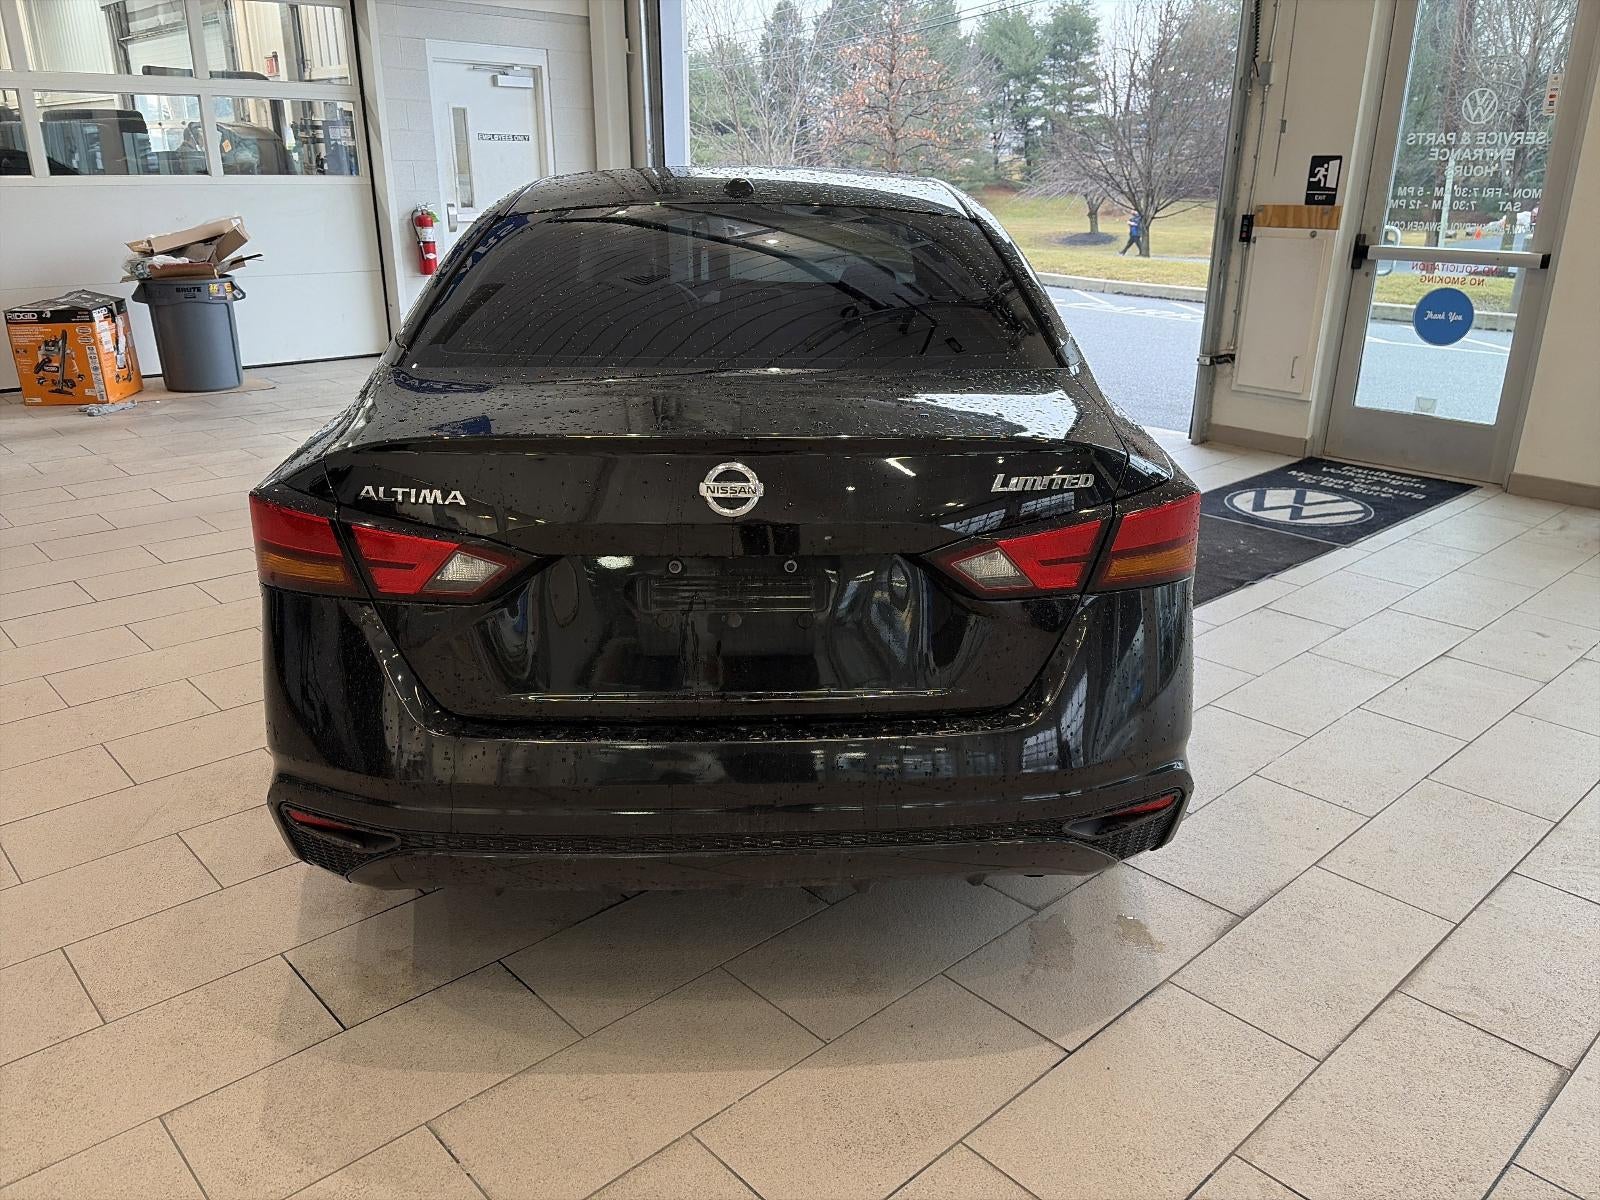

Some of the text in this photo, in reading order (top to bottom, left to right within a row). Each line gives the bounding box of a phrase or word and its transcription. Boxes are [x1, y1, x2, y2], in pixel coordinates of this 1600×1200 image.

[6, 312, 38, 321] RIDGID
[1424, 310, 1463, 323] Thank You
[359, 485, 467, 506] ALTIMA
[706, 486, 757, 495] NISSAN
